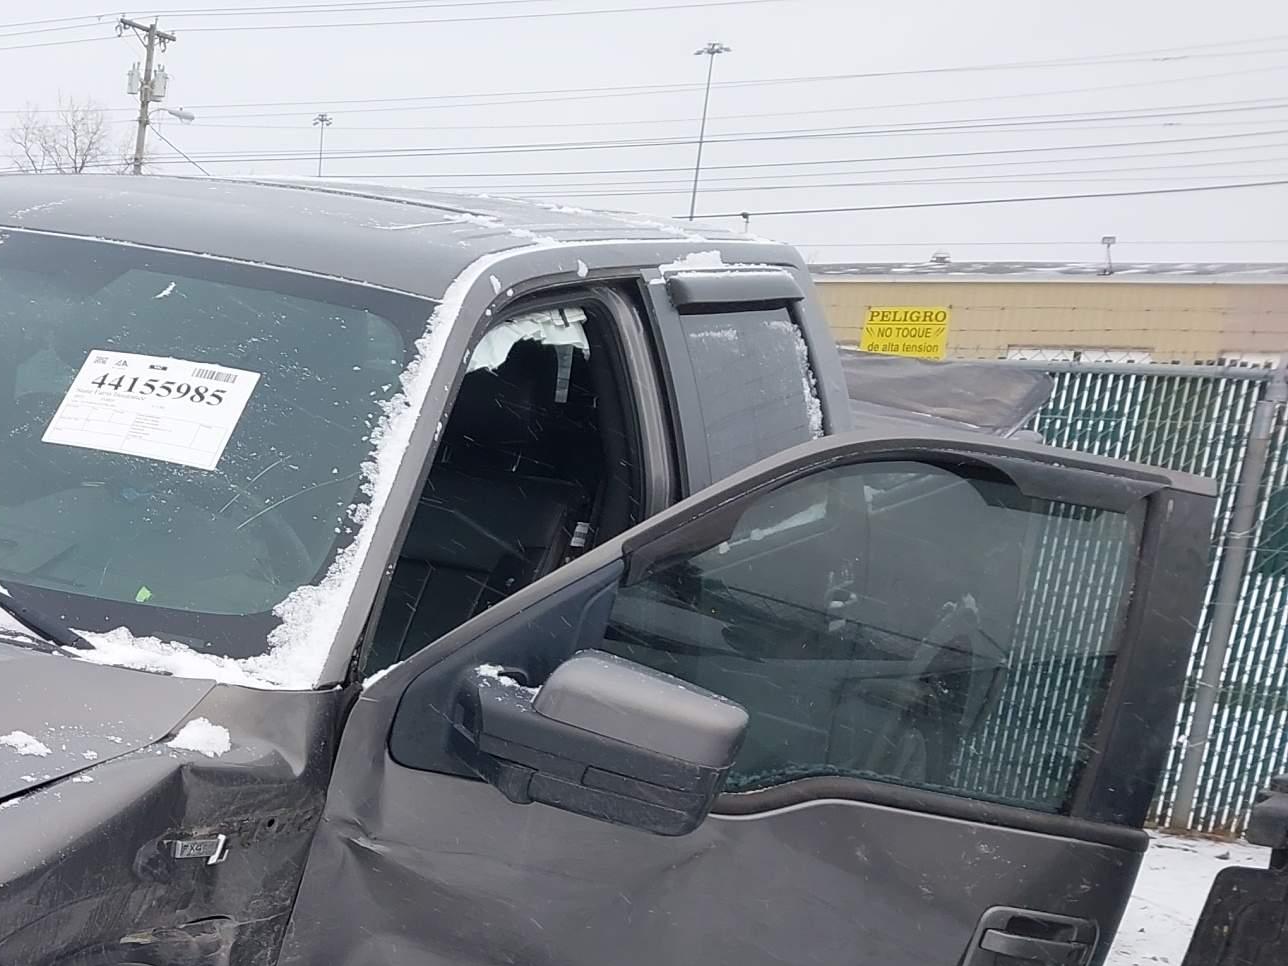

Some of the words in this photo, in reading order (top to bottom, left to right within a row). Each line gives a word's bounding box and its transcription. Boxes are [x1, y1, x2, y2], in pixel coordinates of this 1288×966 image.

[868, 310, 947, 322] PELIGRO
[877, 327, 893, 338] NO
[895, 327, 932, 338] TOQUE
[867, 342, 879, 352] de
[881, 342, 899, 352] alta
[902, 342, 939, 353] tension
[91, 371, 228, 407] 44155985
